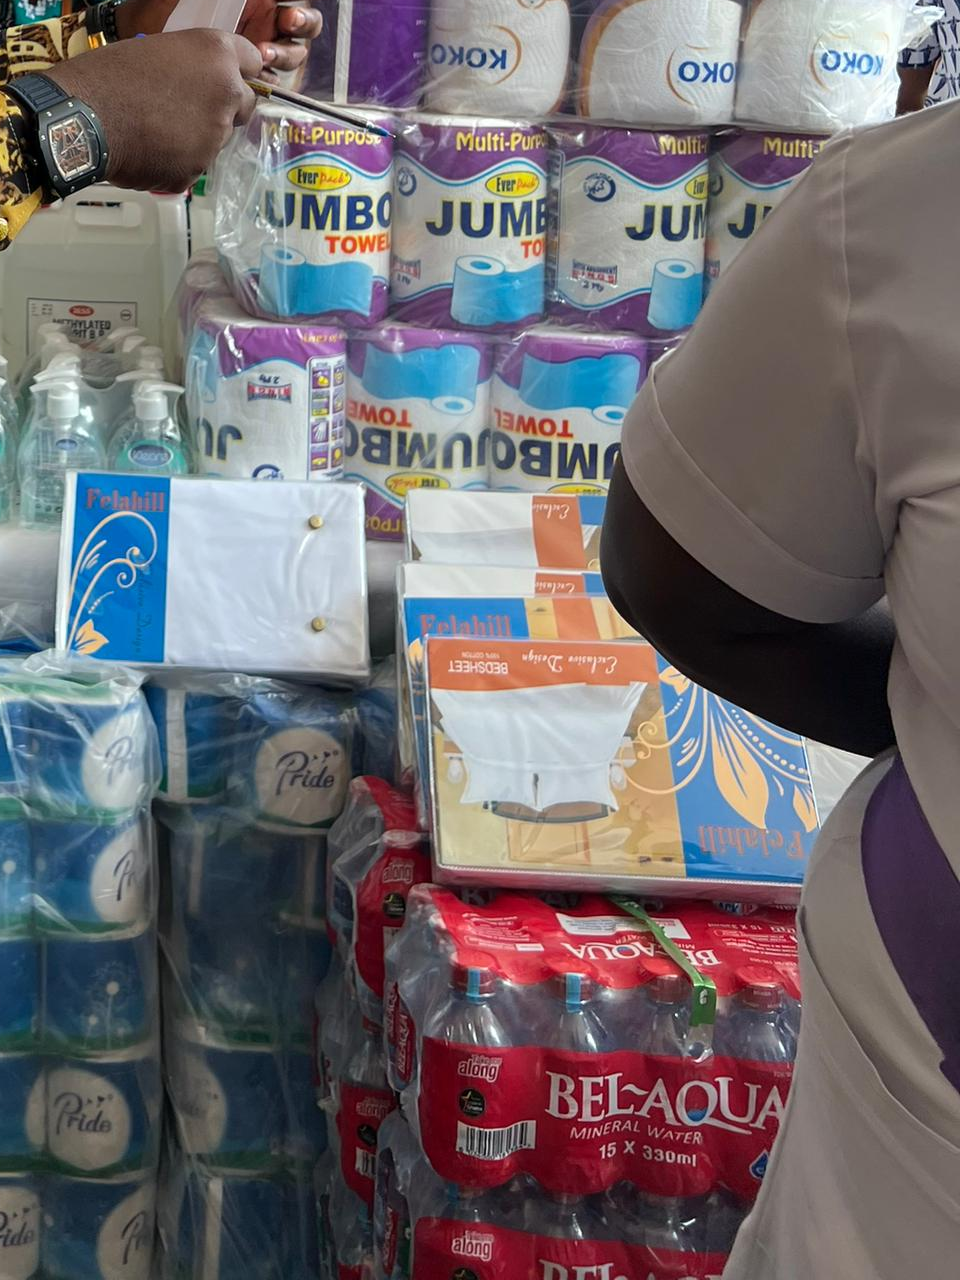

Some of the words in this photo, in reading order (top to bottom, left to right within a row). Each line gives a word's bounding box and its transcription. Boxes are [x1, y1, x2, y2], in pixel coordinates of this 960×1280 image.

[431, 43, 507, 70] KOKO
[820, 49, 884, 76] KOKO
[297, 168, 319, 185] Ever
[495, 177, 516, 192] Ever
[582, 280, 590, 289] 2
[272, 376, 280, 385] 2
[494, 408, 574, 438] TOWEL
[85, 487, 165, 513] Felahill
[448, 659, 509, 675] BEDSHEET
[521, 649, 564, 673] Design
[568, 655, 618, 674] Exclusive
[275, 750, 335, 796] Pride
[458, 1060, 500, 1083] along
[54, 1092, 113, 1135] Pride
[569, 1120, 641, 1140] MINERAL
[647, 1124, 704, 1145] WATER
[599, 1142, 617, 1159] 15
[624, 1140, 635, 1154] X
[642, 1145, 697, 1167] 330ml
[452, 1235, 493, 1260] along
